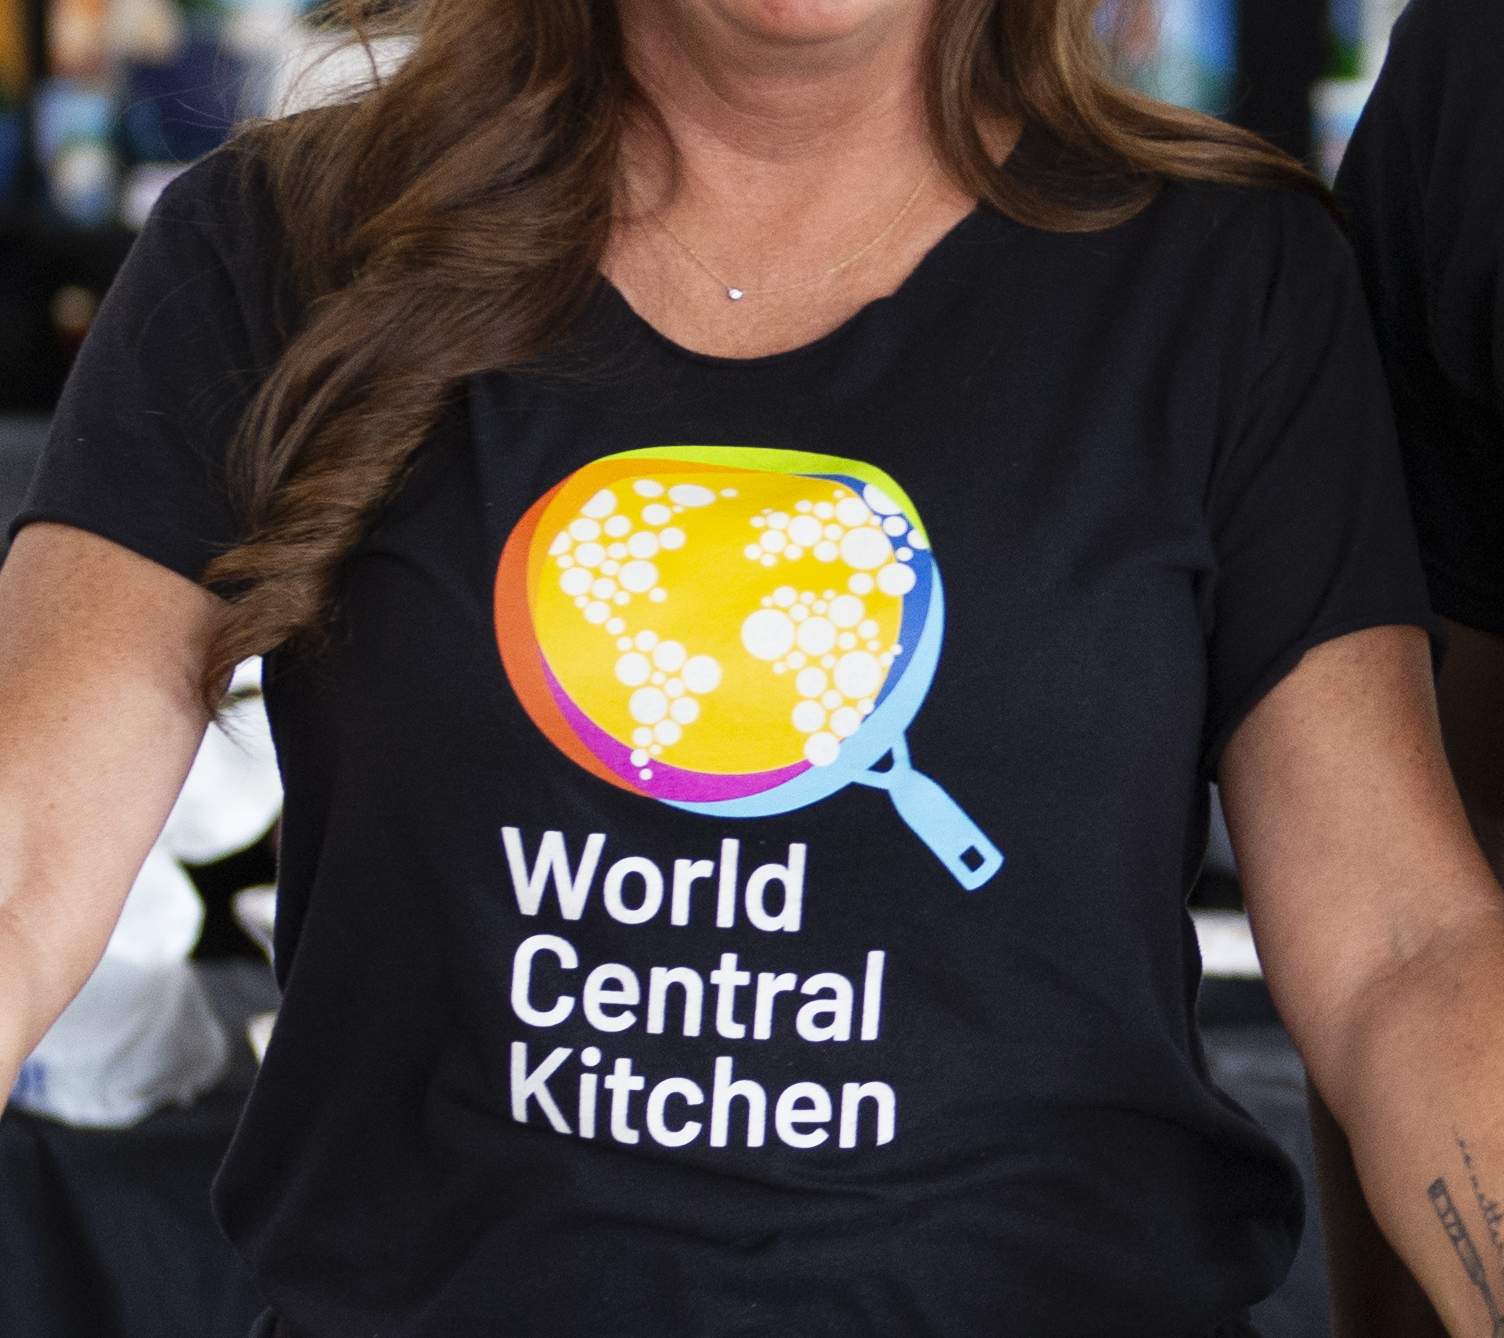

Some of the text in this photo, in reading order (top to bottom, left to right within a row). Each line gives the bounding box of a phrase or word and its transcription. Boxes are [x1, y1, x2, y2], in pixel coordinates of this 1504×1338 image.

[501, 826, 807, 933] World
[510, 934, 885, 1043] Central
[510, 1041, 896, 1149] Kitchen
